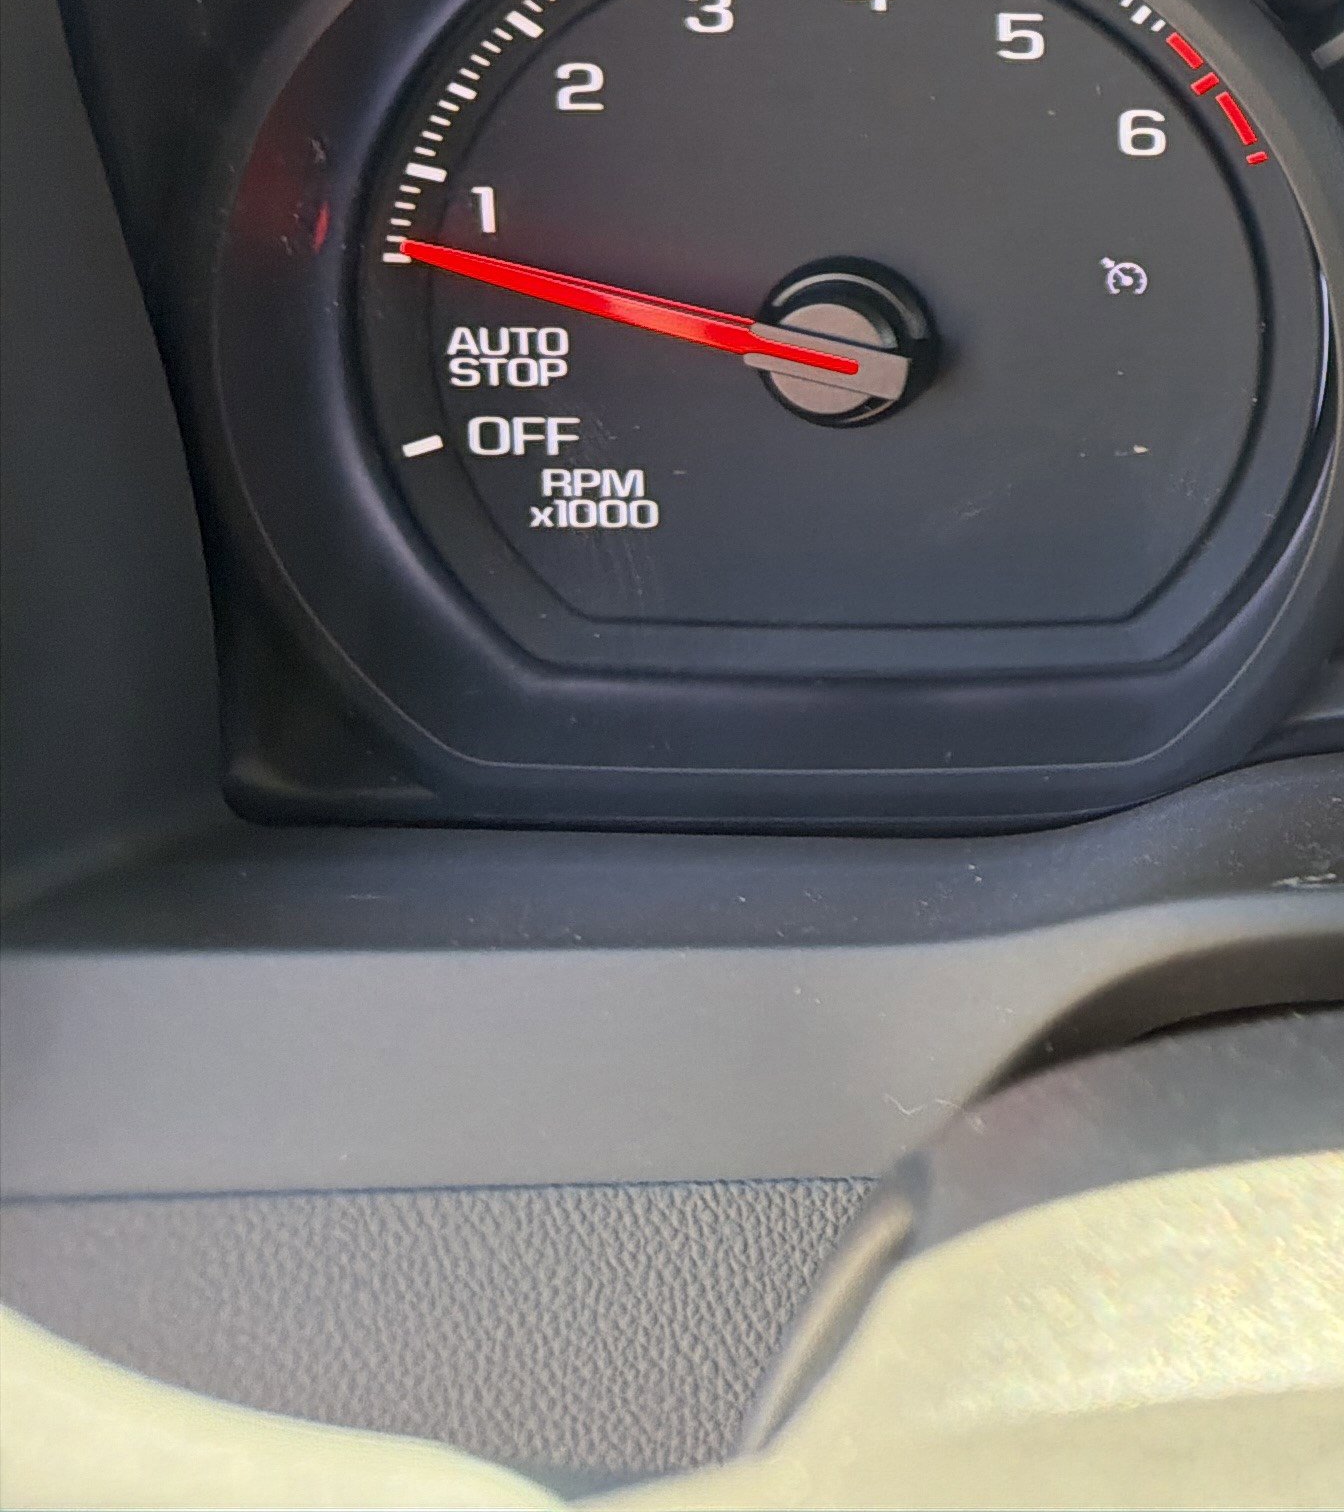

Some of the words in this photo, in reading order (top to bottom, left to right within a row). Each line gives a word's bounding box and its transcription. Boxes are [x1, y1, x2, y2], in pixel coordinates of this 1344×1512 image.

[996, 12, 1045, 60] 5
[555, 62, 604, 111] 2
[1118, 109, 1167, 156] 6
[470, 186, 496, 234] 1
[446, 326, 569, 357] AUTO
[448, 357, 568, 387] STOP
[467, 415, 581, 456] OFF
[541, 468, 645, 498] RPM
[530, 498, 659, 529] x1000
